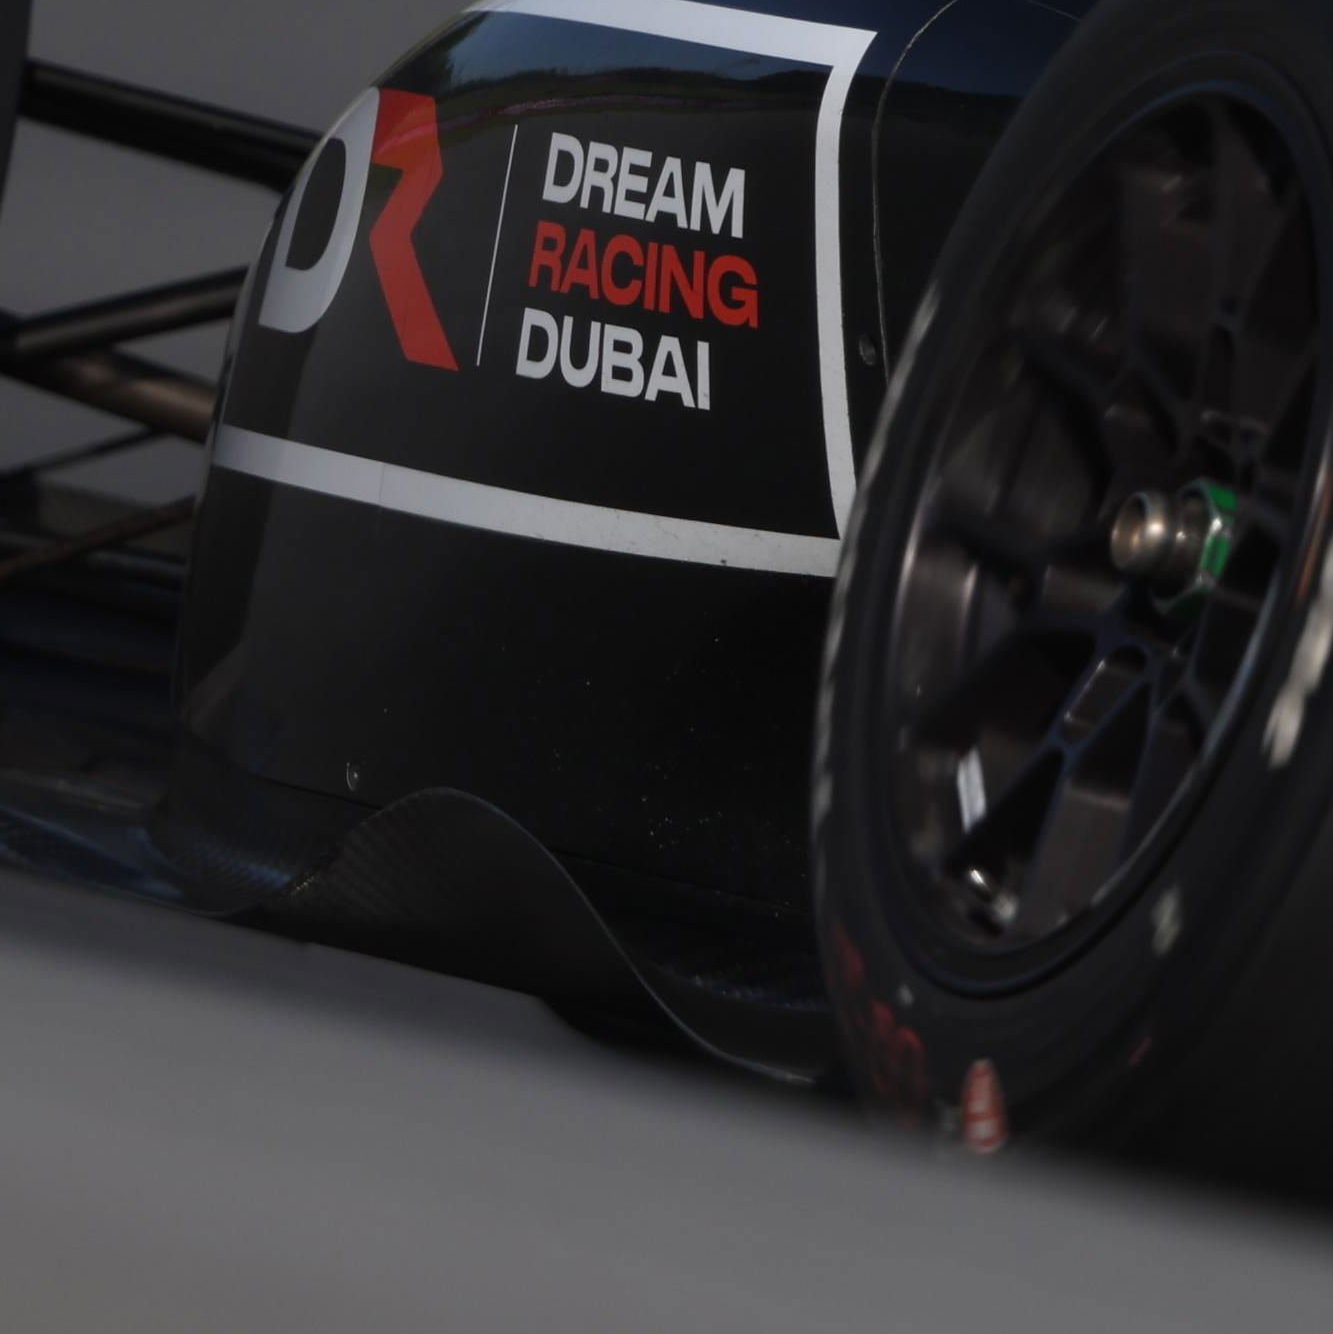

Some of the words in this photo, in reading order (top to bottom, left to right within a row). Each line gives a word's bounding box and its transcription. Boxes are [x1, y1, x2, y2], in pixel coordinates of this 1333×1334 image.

[542, 132, 746, 238] DREAM
[528, 221, 759, 328] RACING
[515, 308, 712, 410] DUBAI
